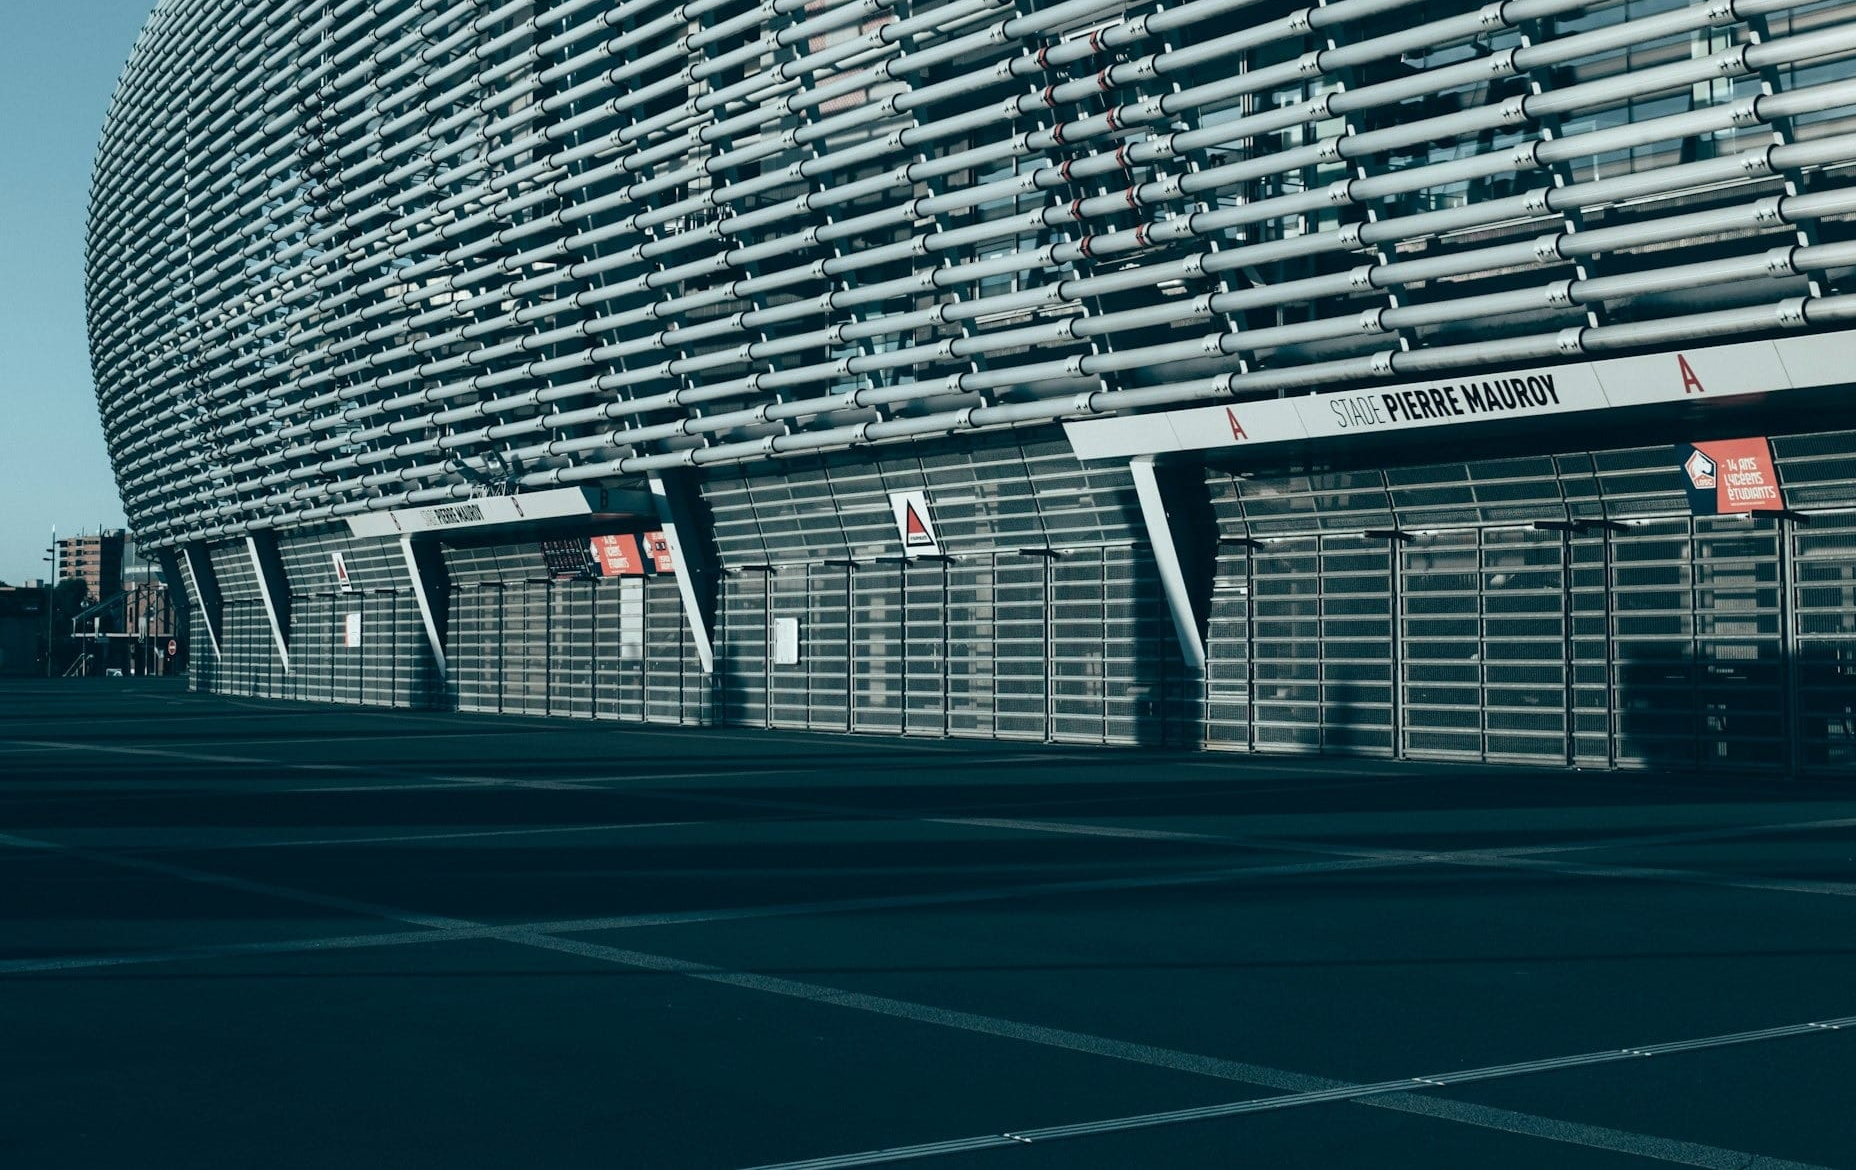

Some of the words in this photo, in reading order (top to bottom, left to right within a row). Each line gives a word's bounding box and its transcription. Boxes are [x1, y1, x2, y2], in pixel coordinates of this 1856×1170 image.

[1677, 353, 1705, 394] A
[1329, 395, 1386, 429] STADE
[1381, 386, 1464, 423] PIERRE
[1460, 373, 1561, 414] MAUROY
[1226, 406, 1248, 441] A
